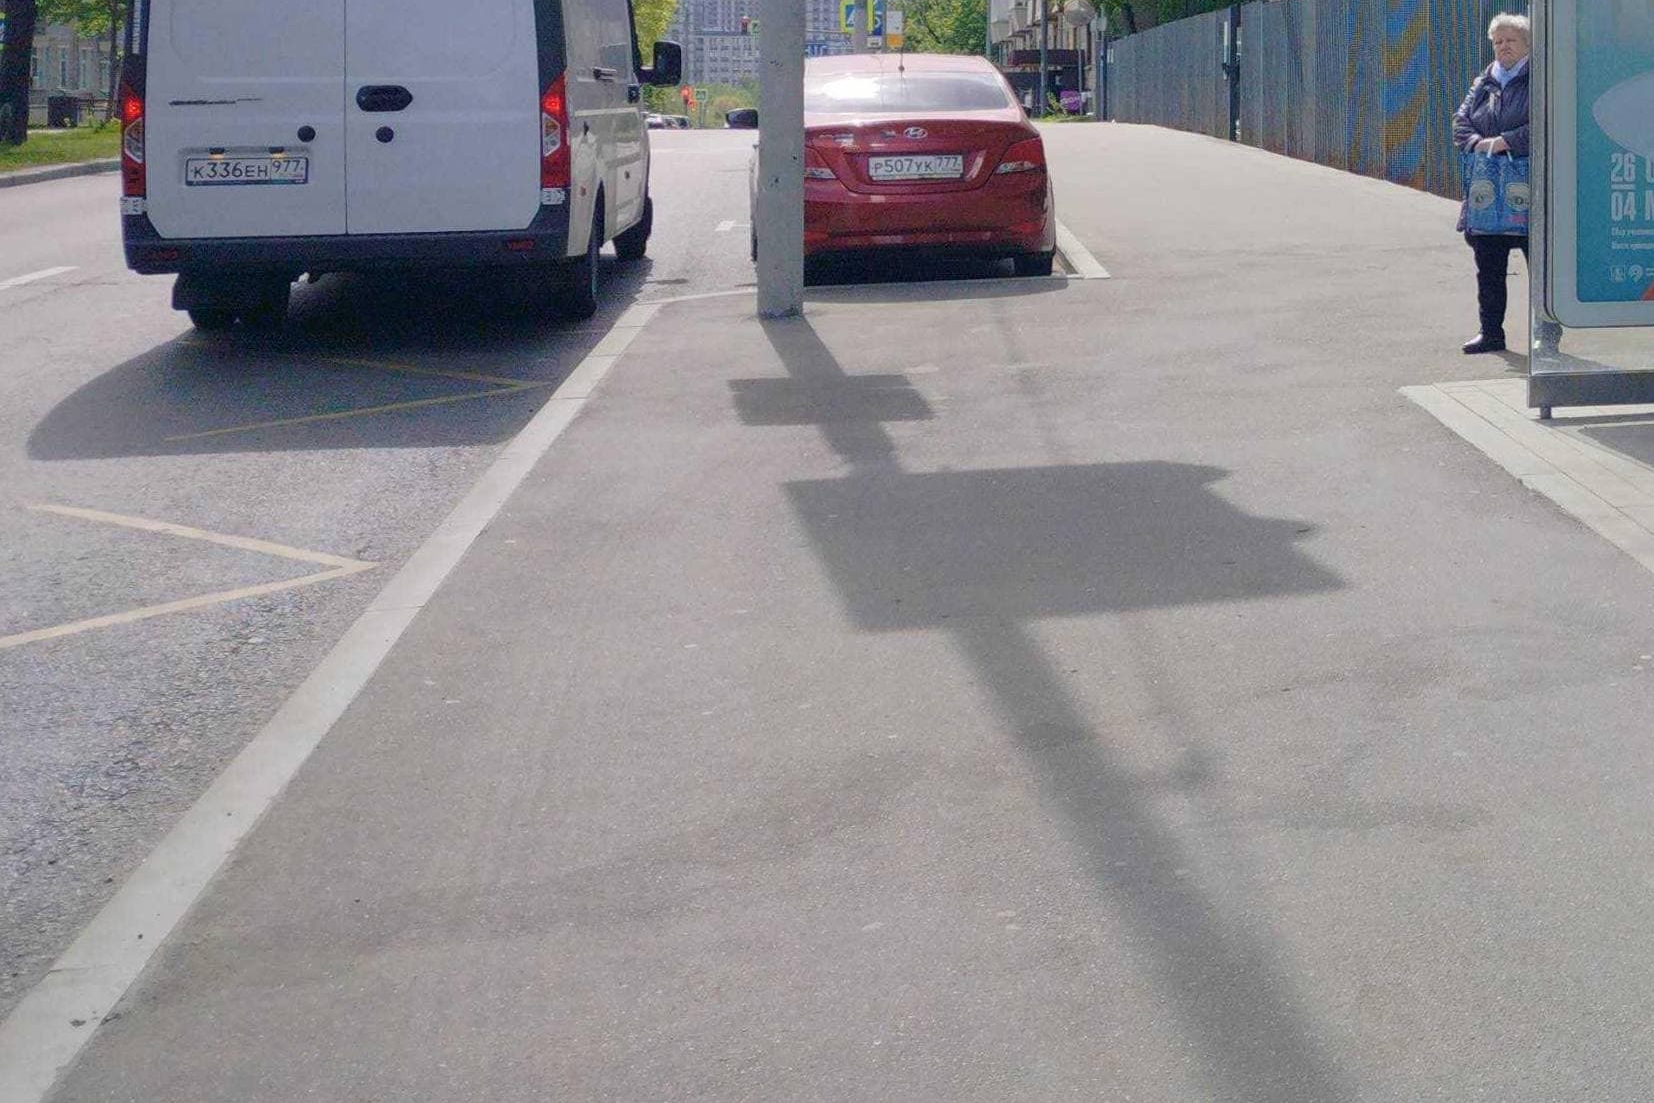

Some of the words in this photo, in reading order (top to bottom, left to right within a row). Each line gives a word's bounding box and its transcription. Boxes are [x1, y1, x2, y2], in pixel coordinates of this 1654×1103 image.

[193, 161, 268, 179] К336ЕН
[272, 159, 300, 173] 977
[873, 158, 932, 174] Р507УК
[937, 156, 959, 169] 777
[1611, 152, 1636, 182] 26
[1611, 191, 1635, 221] 04
